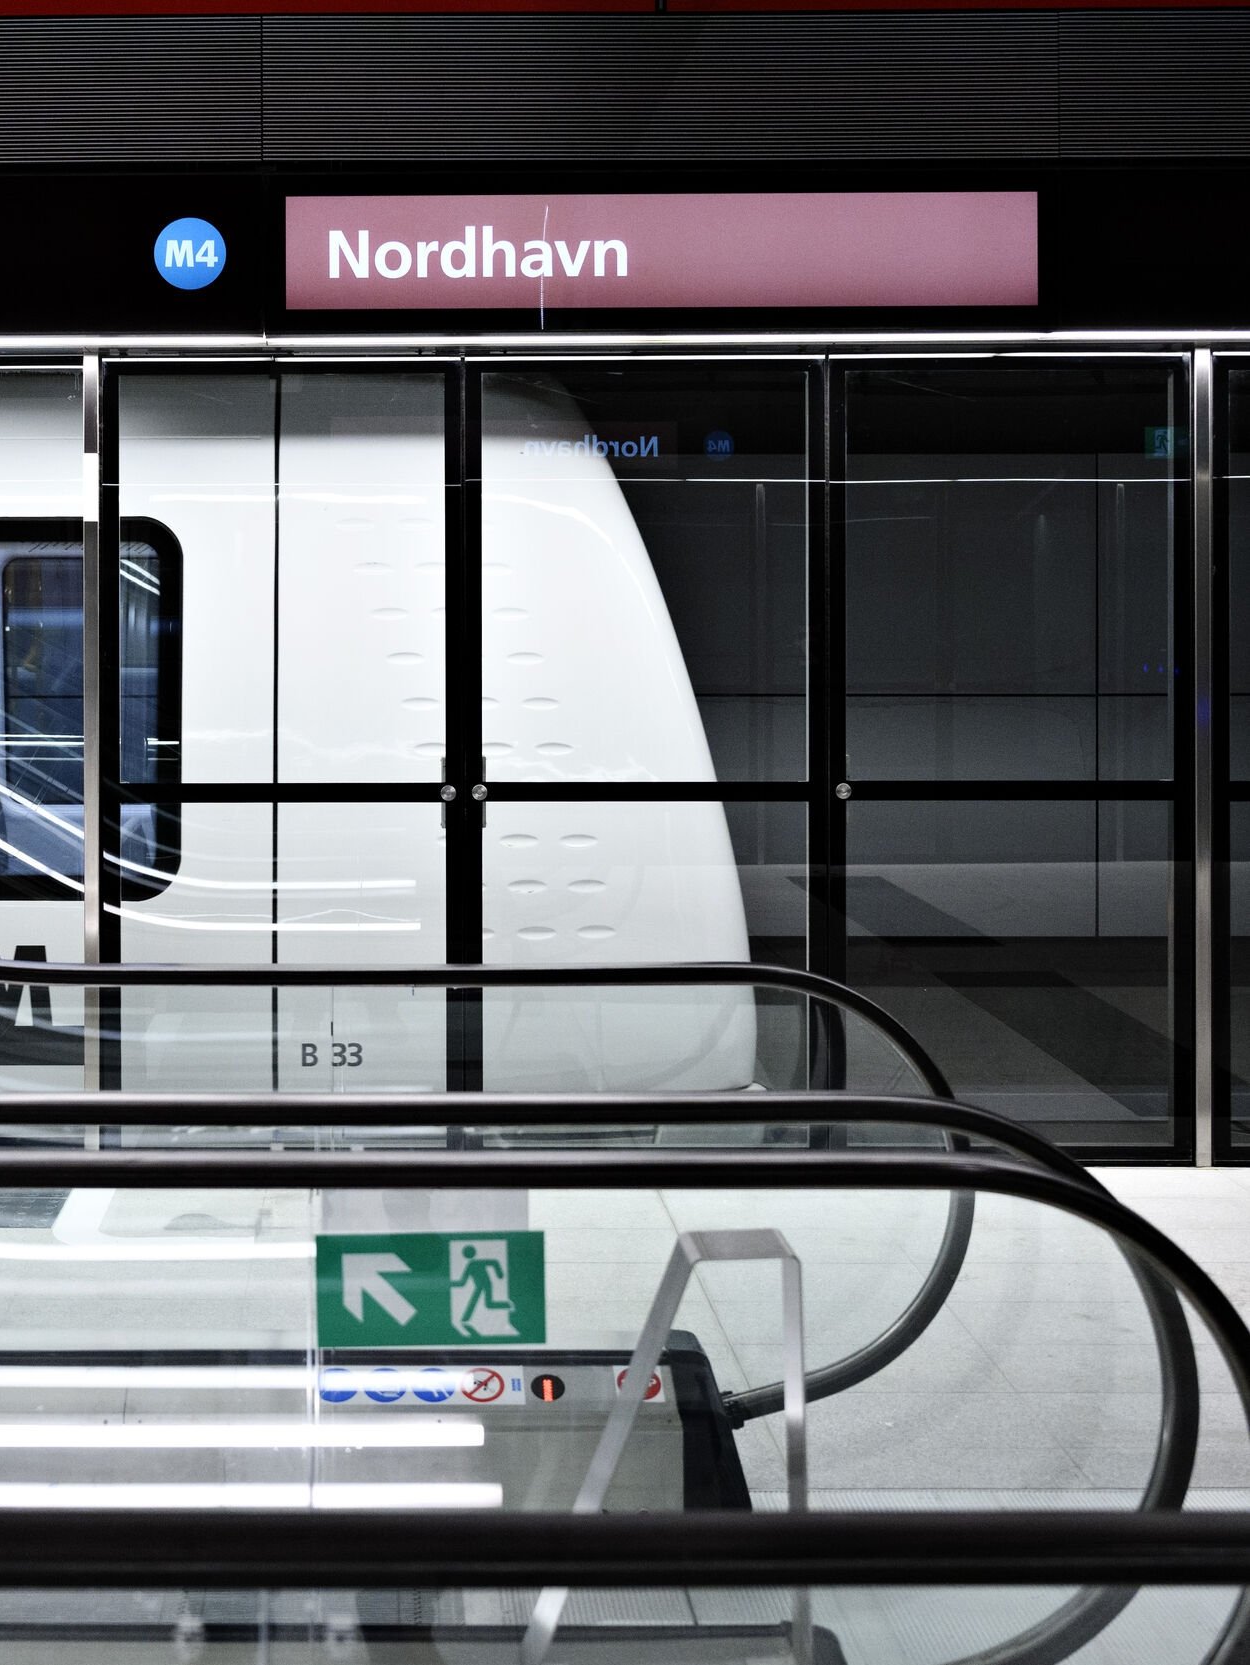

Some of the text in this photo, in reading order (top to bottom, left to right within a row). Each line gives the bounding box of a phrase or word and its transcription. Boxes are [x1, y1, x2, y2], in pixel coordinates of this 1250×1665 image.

[165, 239, 218, 268] M4
[328, 226, 628, 279] Nordhavn
[301, 1043, 363, 1067] B 33
